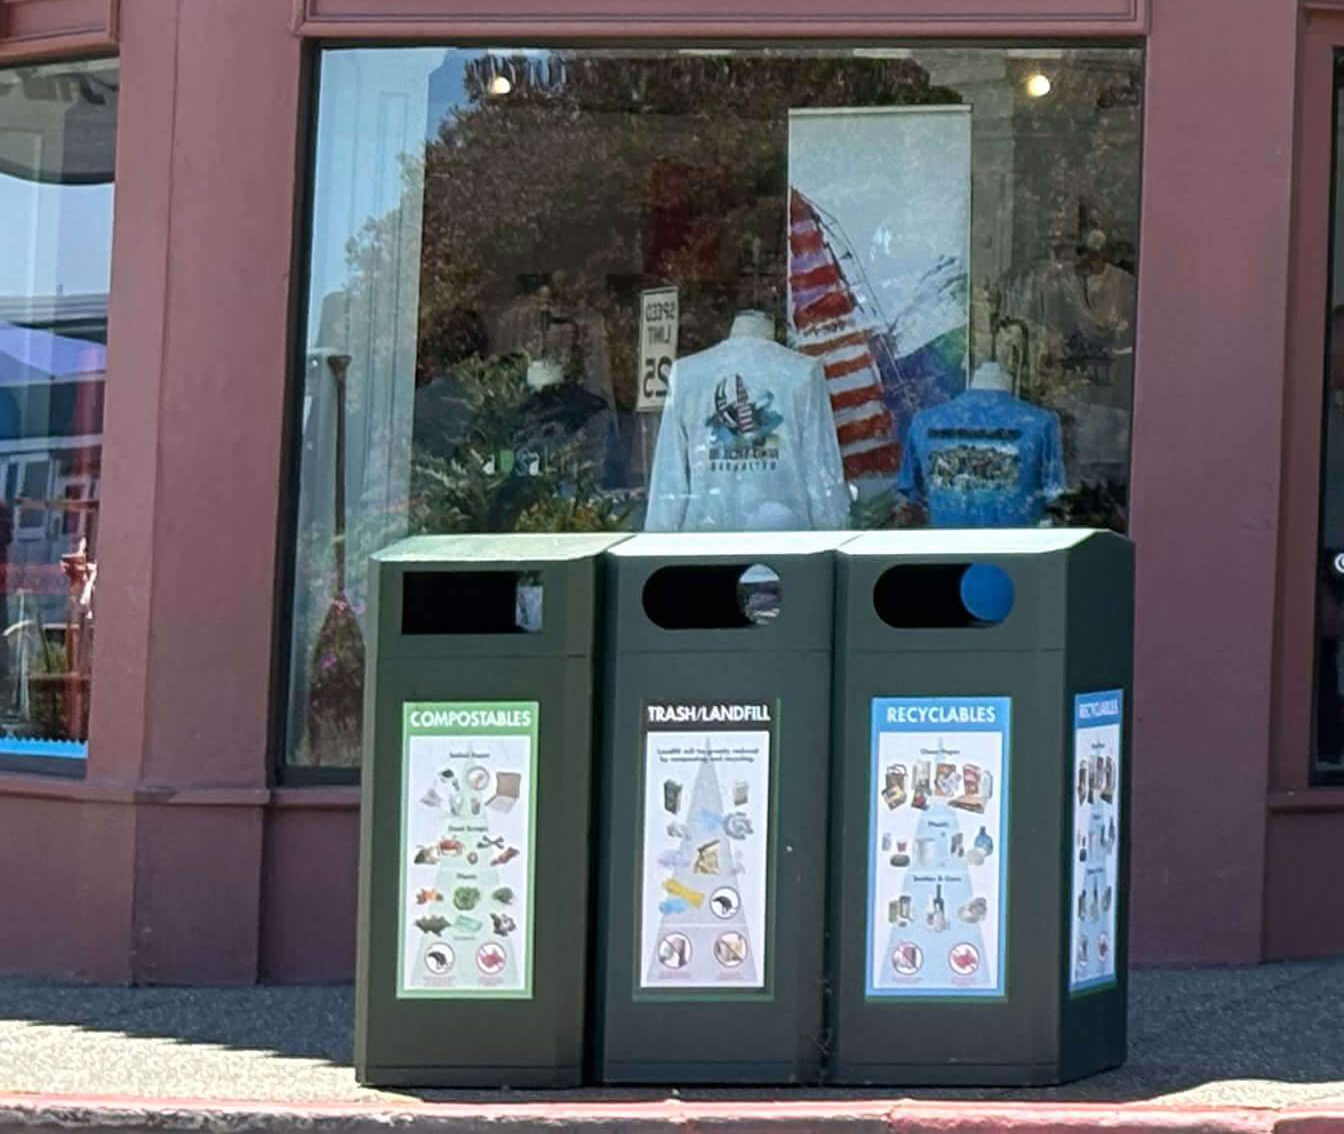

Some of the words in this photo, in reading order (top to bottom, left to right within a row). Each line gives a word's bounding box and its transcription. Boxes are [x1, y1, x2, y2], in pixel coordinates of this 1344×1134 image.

[410, 709, 532, 728] COMPOSTABLES
[647, 704, 772, 723] TRASH/LANDFILL
[886, 705, 997, 724] RECYCLABLES
